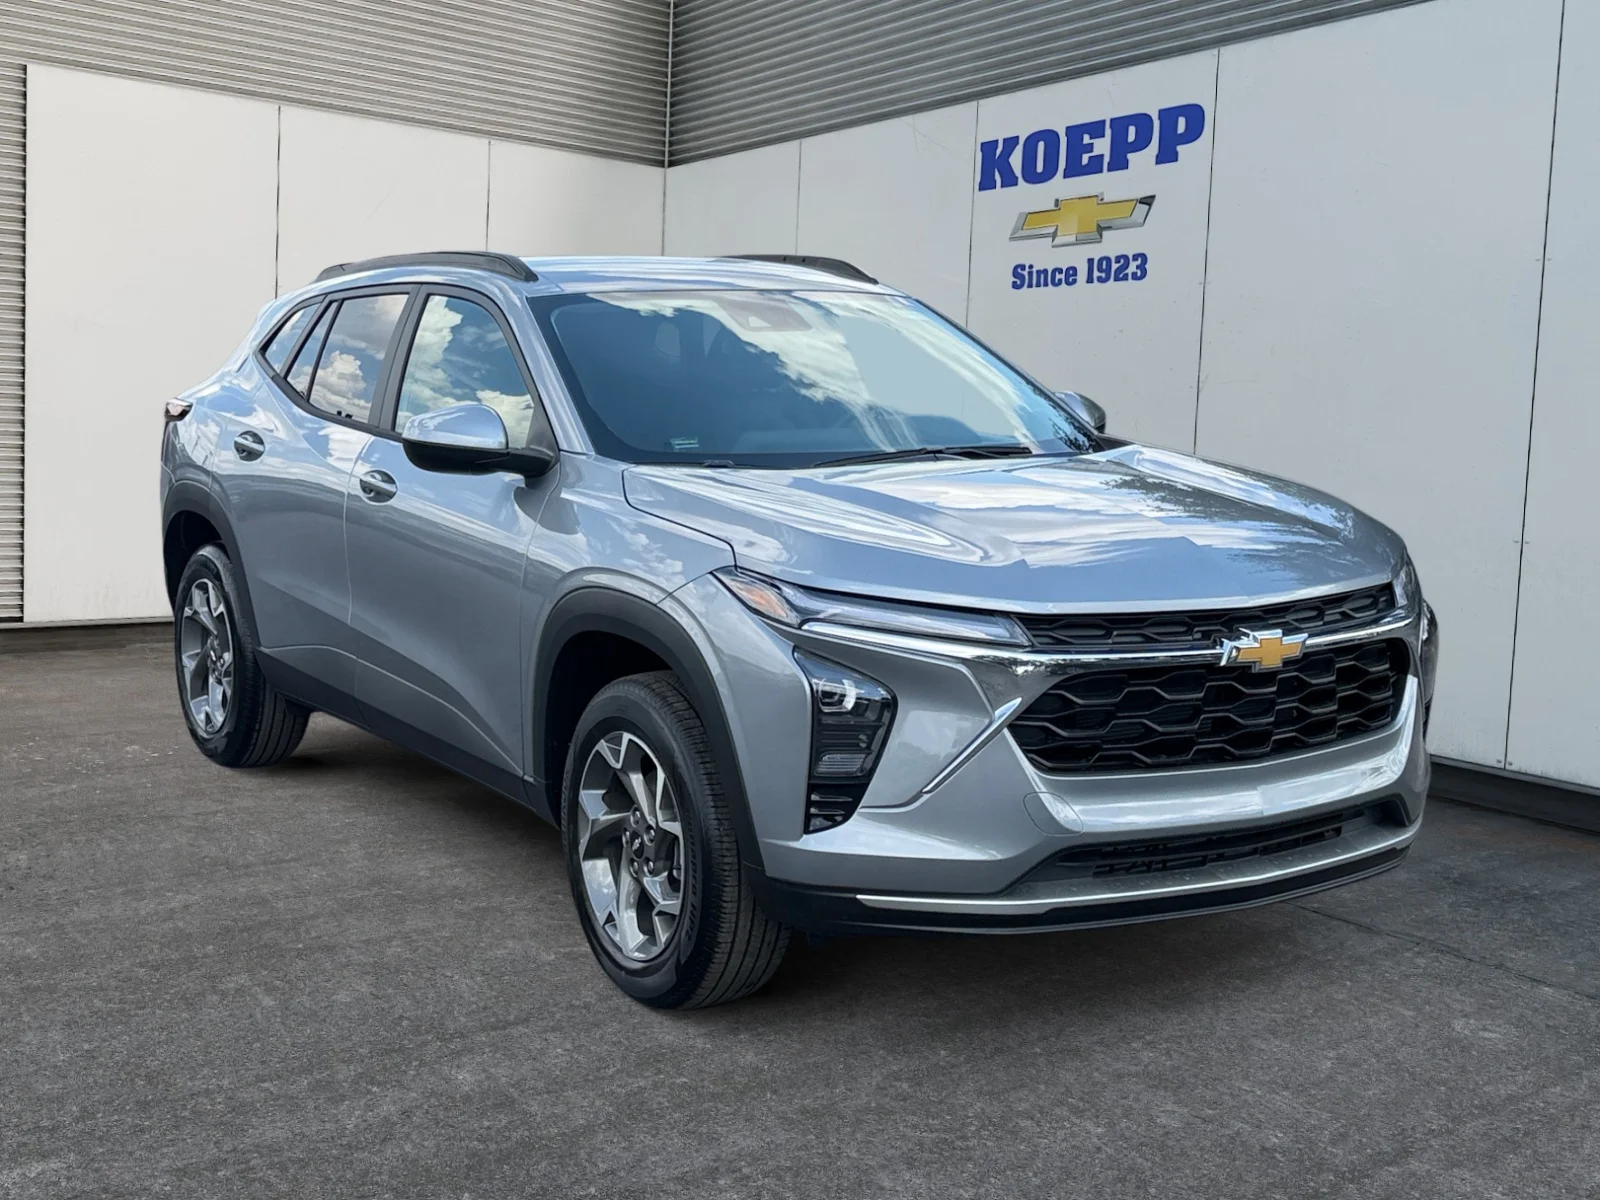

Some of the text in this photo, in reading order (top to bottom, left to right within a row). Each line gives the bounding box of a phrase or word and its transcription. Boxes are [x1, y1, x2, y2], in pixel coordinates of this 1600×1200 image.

[978, 103, 1205, 191] KOEPP
[1011, 252, 1148, 290] Since 1923
